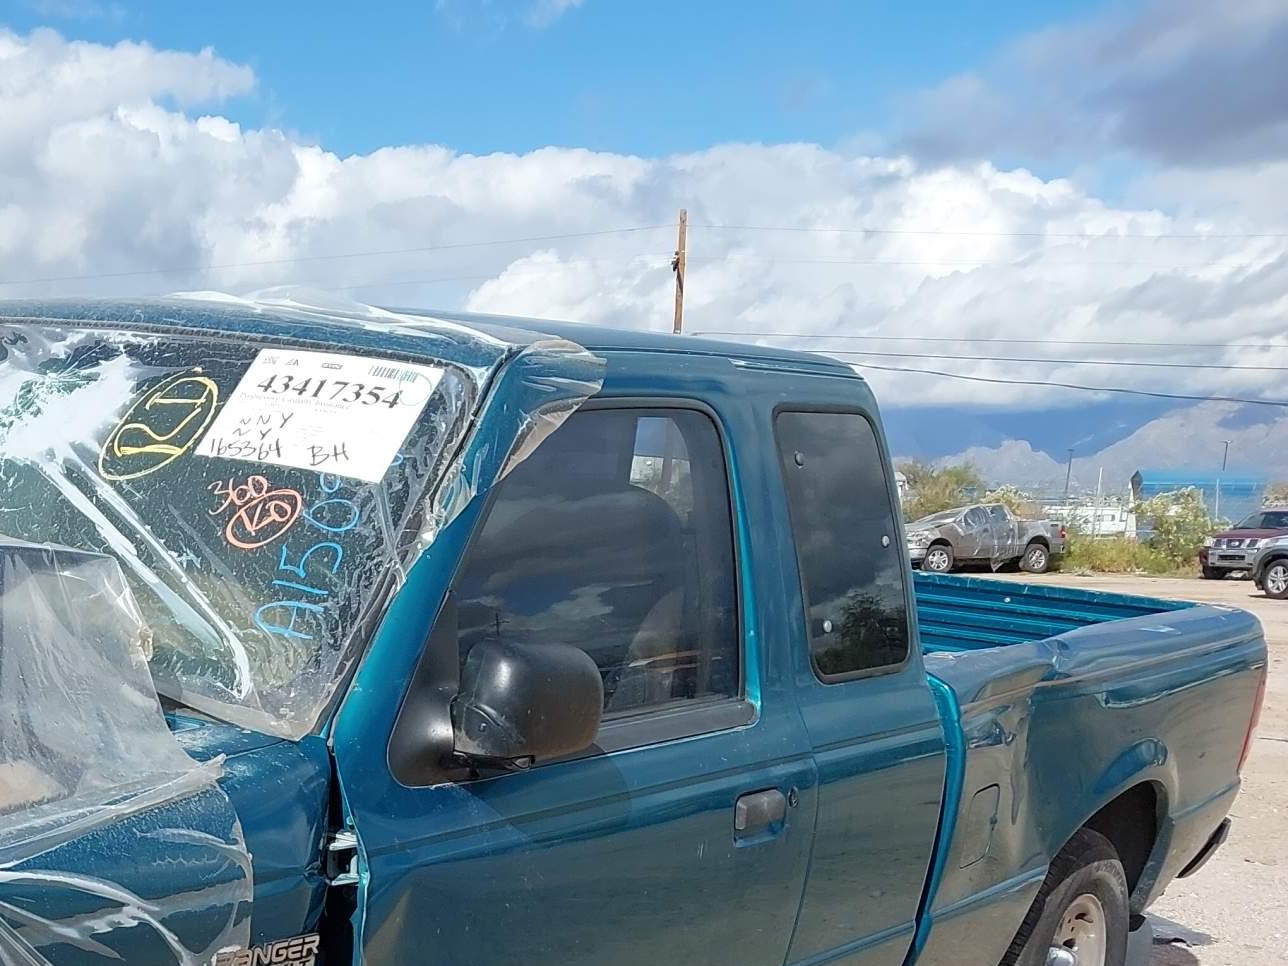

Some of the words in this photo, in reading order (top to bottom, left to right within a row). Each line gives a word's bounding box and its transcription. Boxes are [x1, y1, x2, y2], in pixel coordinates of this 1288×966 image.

[257, 373, 405, 409] 43417354
[279, 411, 294, 429] Y
[306, 441, 350, 466] BH
[207, 474, 268, 516] 360
